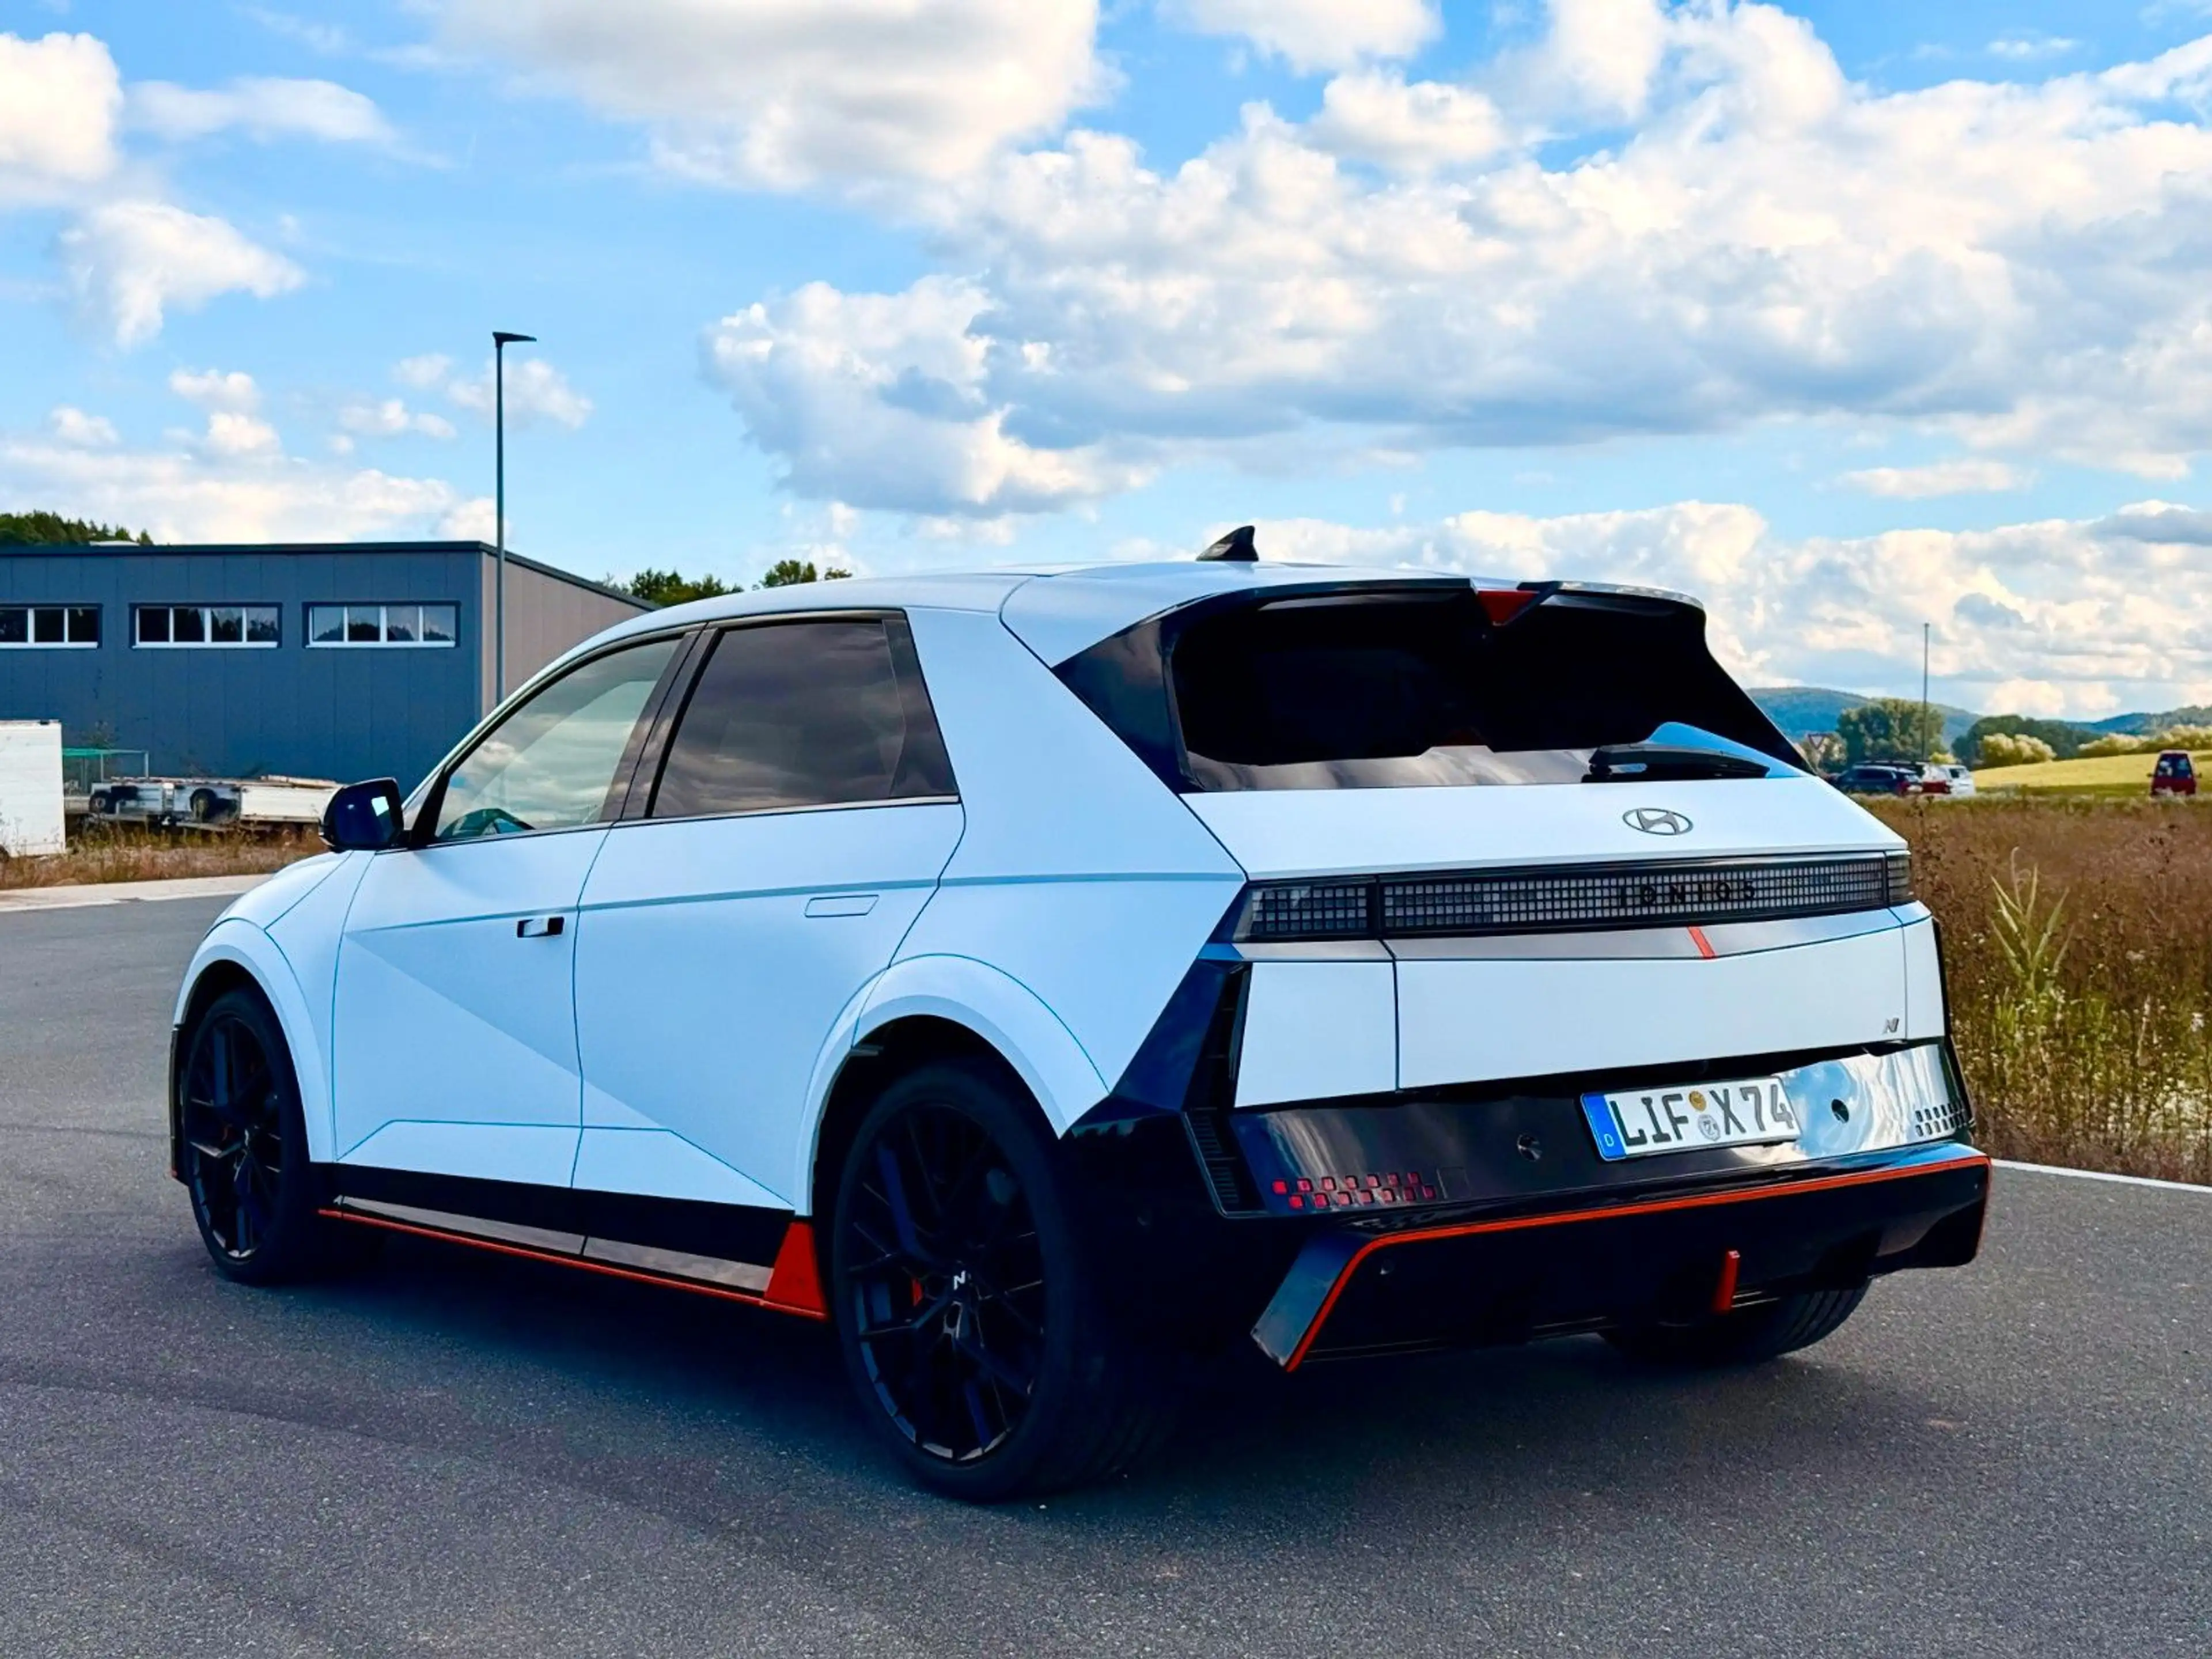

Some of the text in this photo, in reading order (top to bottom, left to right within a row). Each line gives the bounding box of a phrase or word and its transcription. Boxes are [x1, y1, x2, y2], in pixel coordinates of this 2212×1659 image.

[1609, 1084, 1794, 1146] LIF X74
[953, 1270, 966, 1290] N
